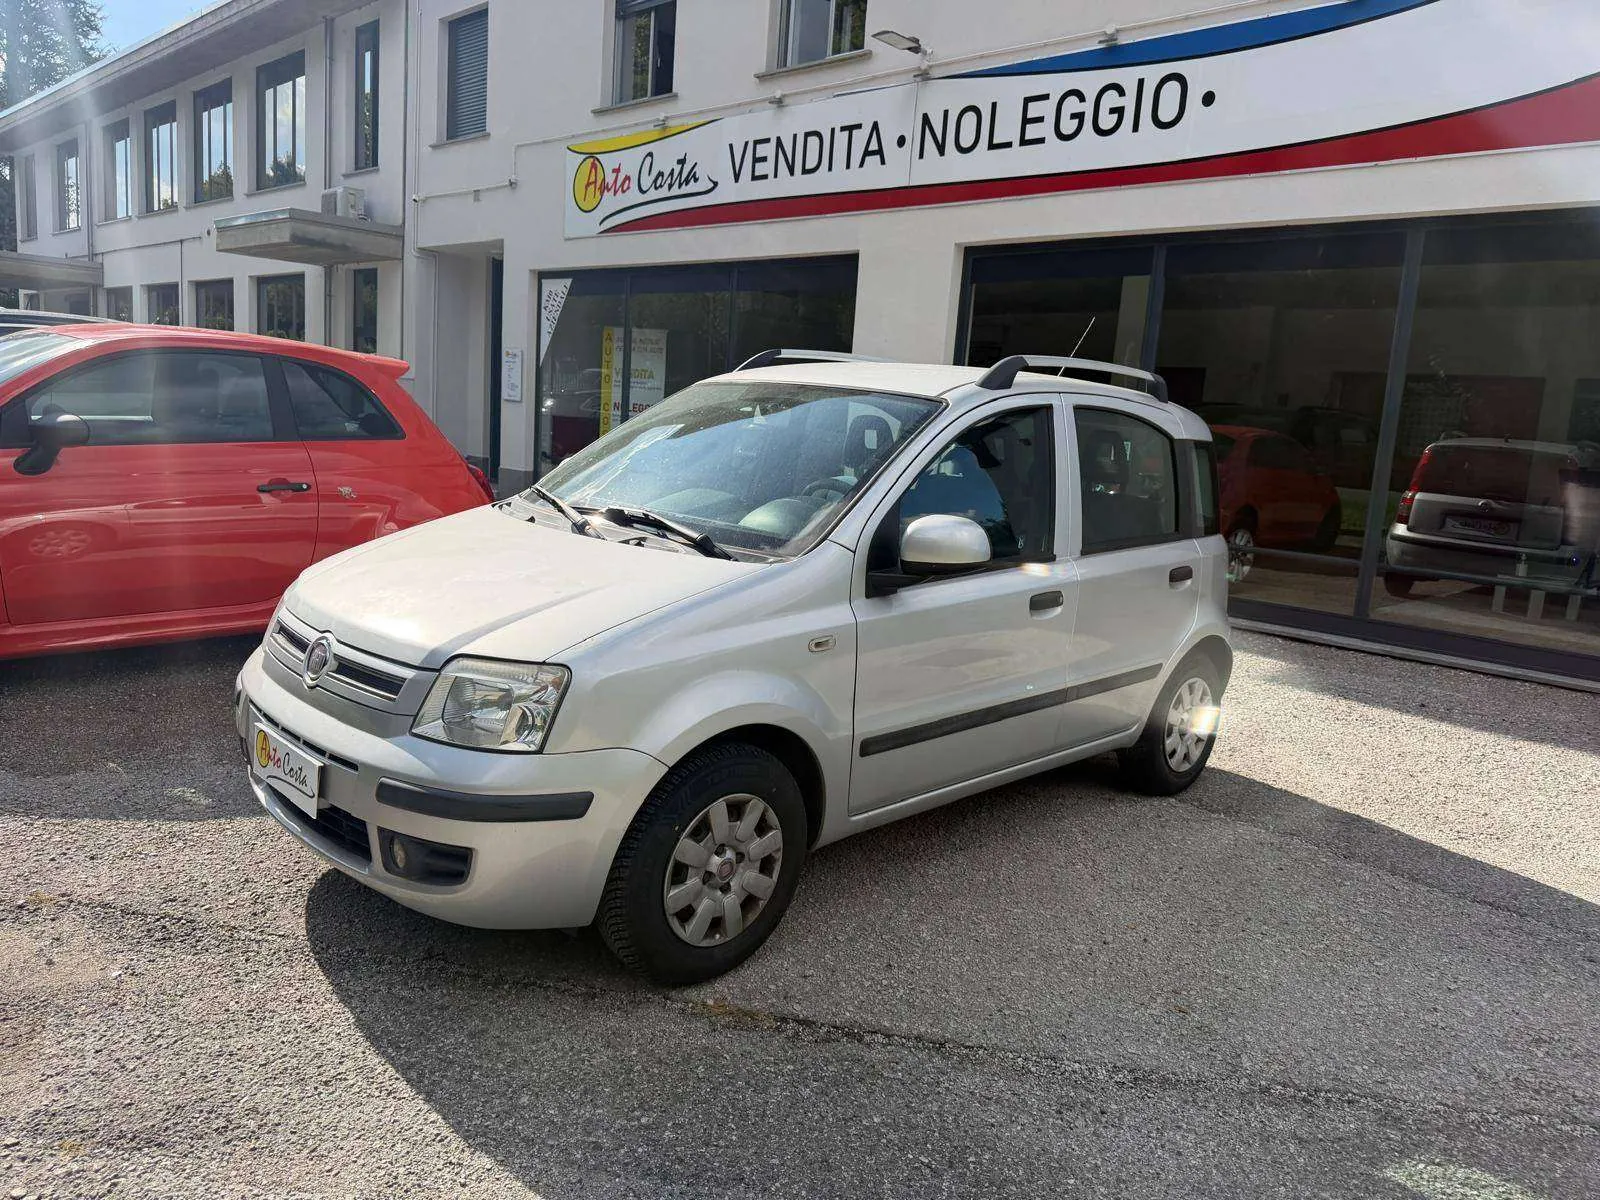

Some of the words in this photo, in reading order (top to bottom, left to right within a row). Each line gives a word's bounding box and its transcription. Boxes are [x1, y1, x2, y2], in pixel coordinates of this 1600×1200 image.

[728, 120, 887, 184] VENDITA
[918, 72, 1189, 160] NOLEGGIO
[583, 158, 632, 202] Auto
[637, 151, 700, 195] Costa
[260, 733, 282, 769] Auto
[283, 752, 308, 787] Costa
